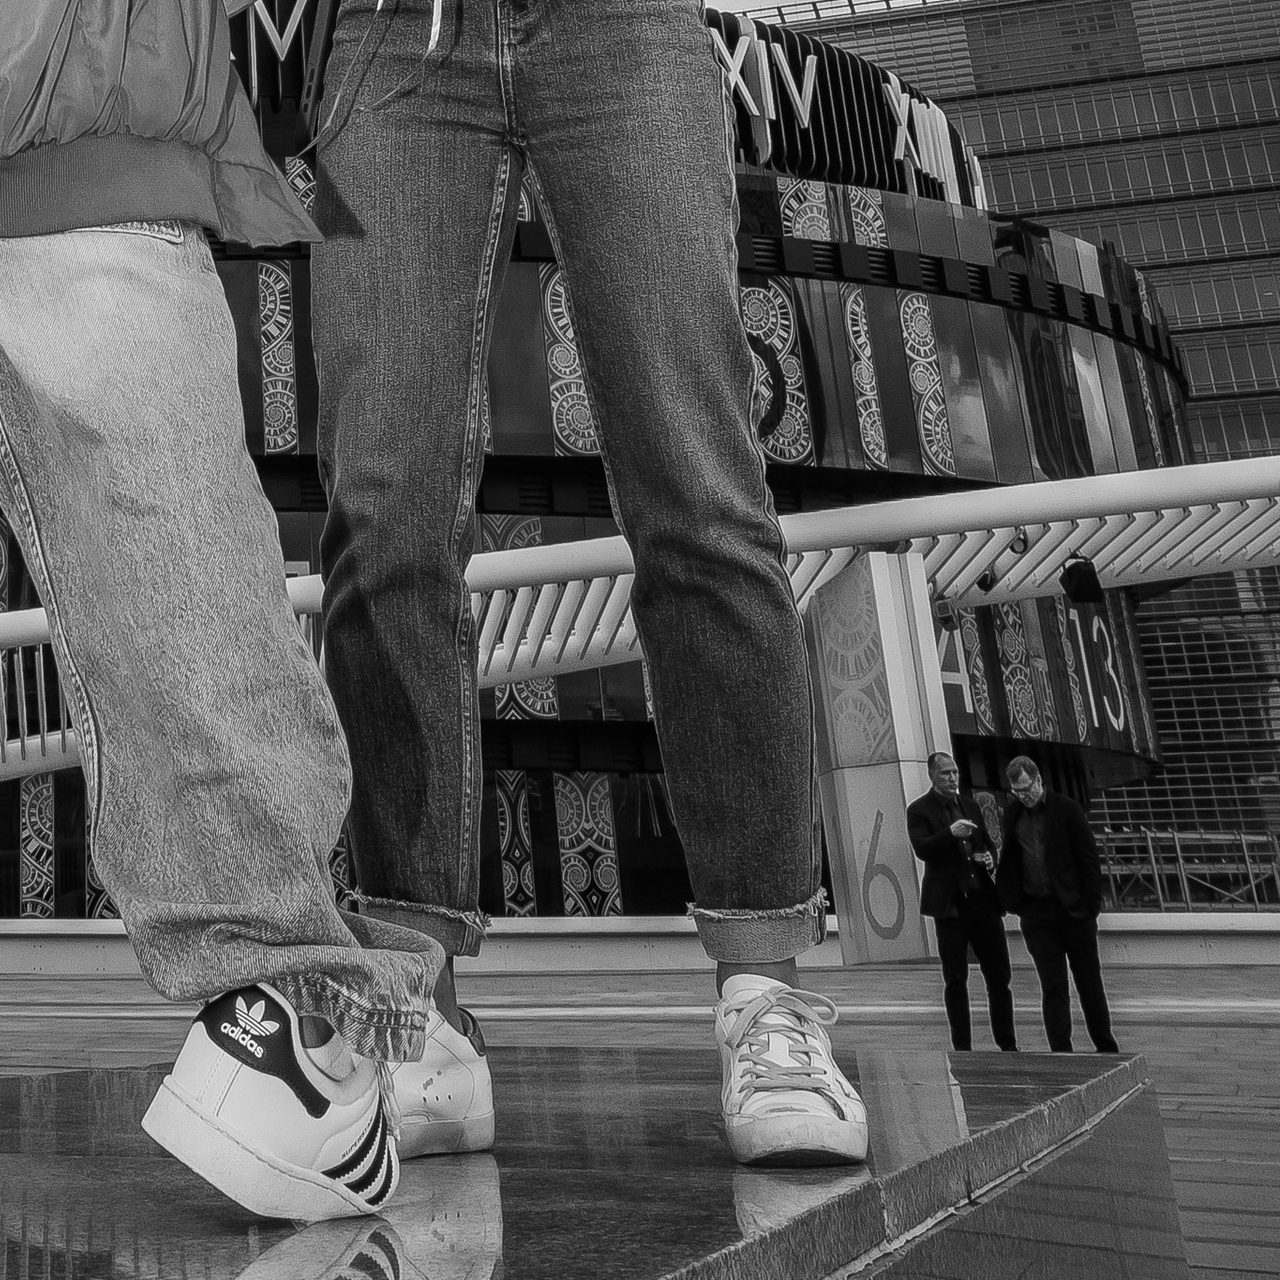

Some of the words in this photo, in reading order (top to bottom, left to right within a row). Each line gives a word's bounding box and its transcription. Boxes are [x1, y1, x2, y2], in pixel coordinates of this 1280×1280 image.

[709, 26, 818, 130] XIV
[1069, 608, 1125, 732] 13
[862, 808, 906, 940] 6
[220, 1022, 264, 1058] adidas
